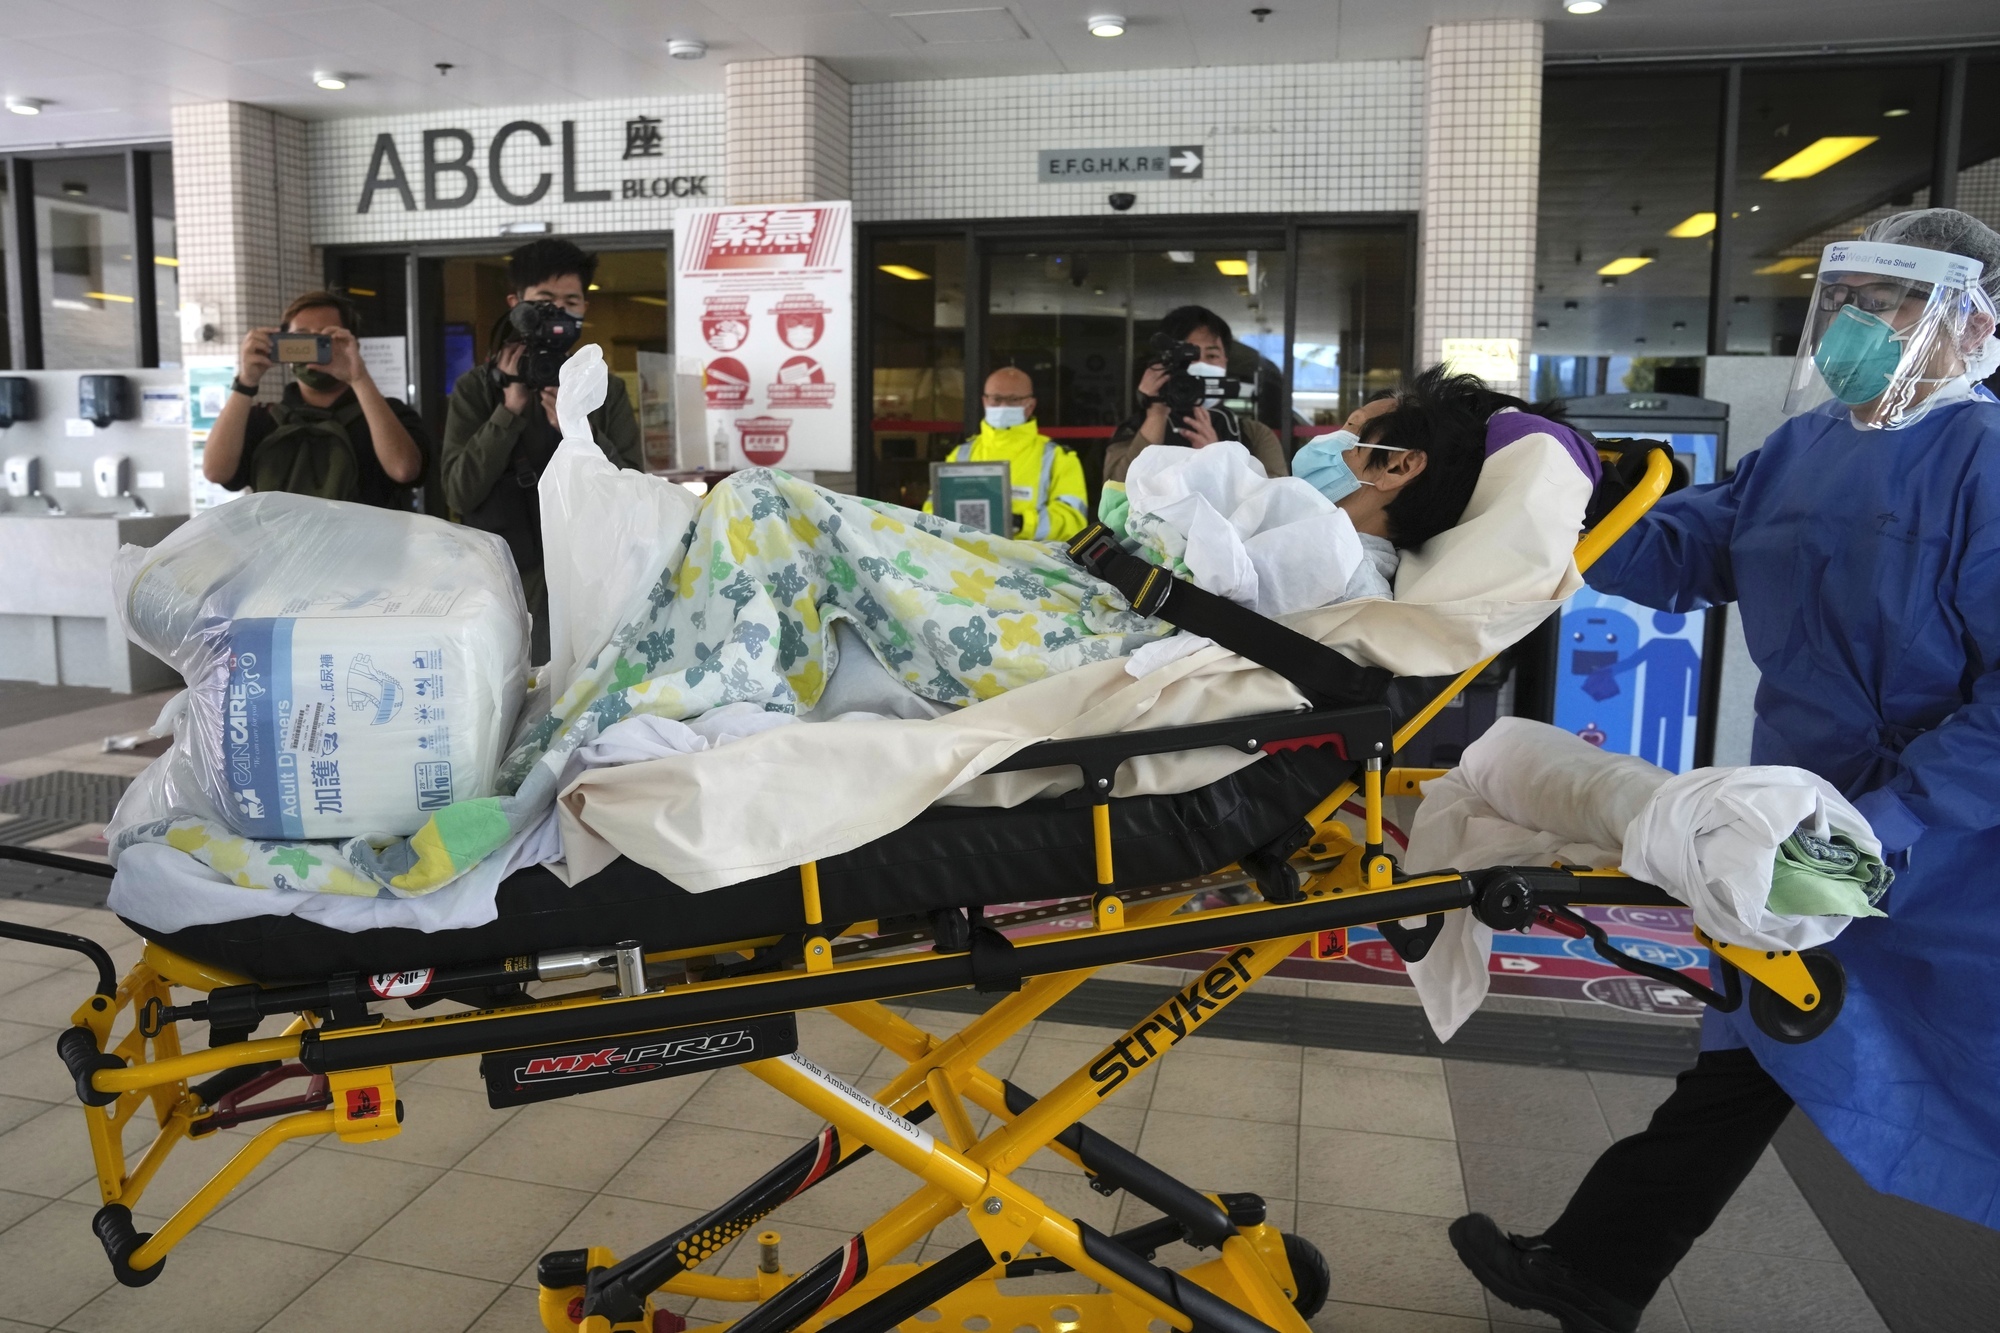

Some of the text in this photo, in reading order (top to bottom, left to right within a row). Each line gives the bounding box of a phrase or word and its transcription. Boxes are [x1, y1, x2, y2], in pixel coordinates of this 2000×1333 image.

[622, 115, 663, 160] 座
[356, 120, 611, 214] ABCL
[622, 175, 708, 200] BLOCK
[711, 211, 816, 248] 緊急
[1875, 256, 1892, 265] Face
[1893, 259, 1916, 269] Shield
[230, 652, 266, 786] CANCARE pro
[250, 716, 259, 728] for
[277, 700, 298, 818] Adult Ders
[420, 789, 451, 808] M
[434, 776, 450, 789] 10
[445, 1009, 495, 1020] 650 LB
[1089, 946, 1255, 1098] stryker
[525, 1029, 745, 1075] MX-PRO
[824, 1073, 871, 1107] Ambulance
